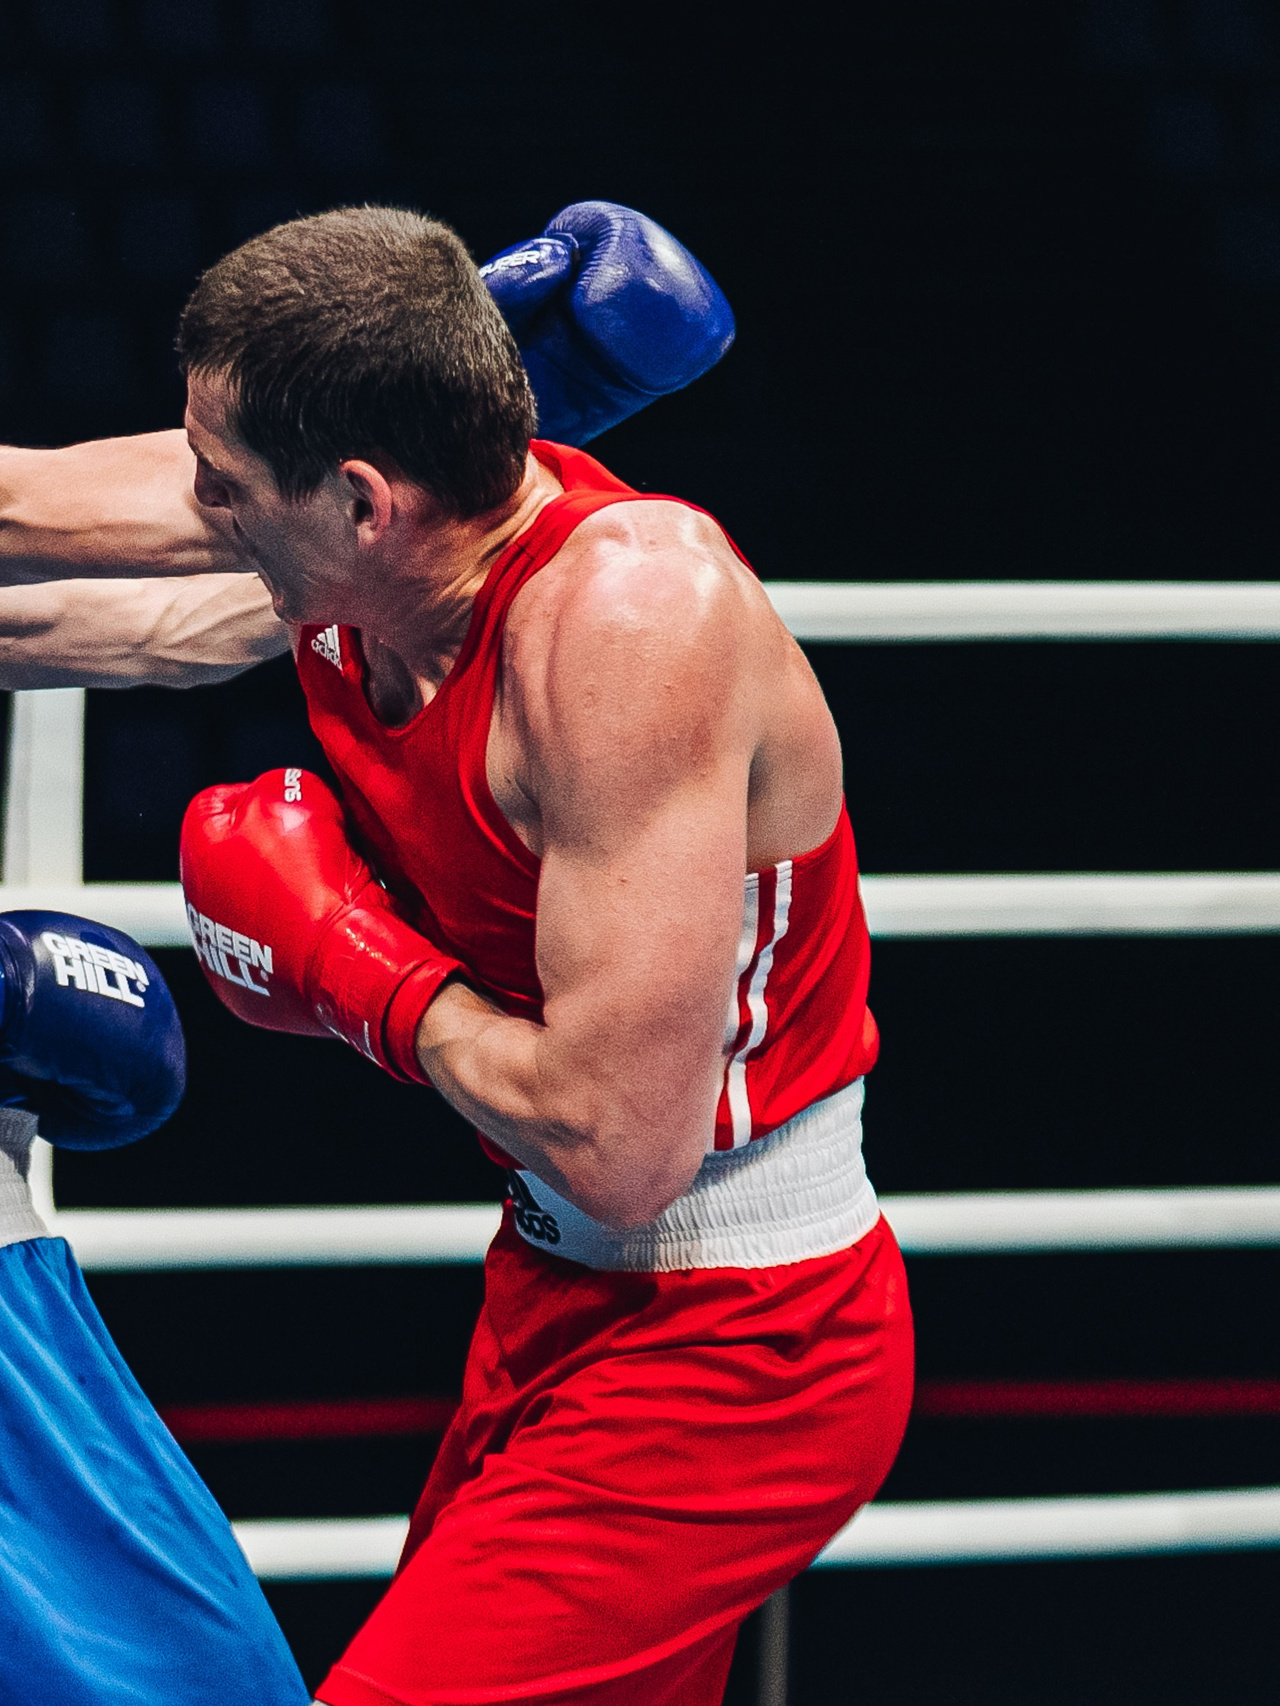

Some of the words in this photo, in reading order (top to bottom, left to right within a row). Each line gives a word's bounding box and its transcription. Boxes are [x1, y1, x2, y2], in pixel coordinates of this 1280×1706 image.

[41, 931, 150, 986] GREEN
[186, 902, 274, 974] GREEN
[53, 954, 146, 1009] HILL
